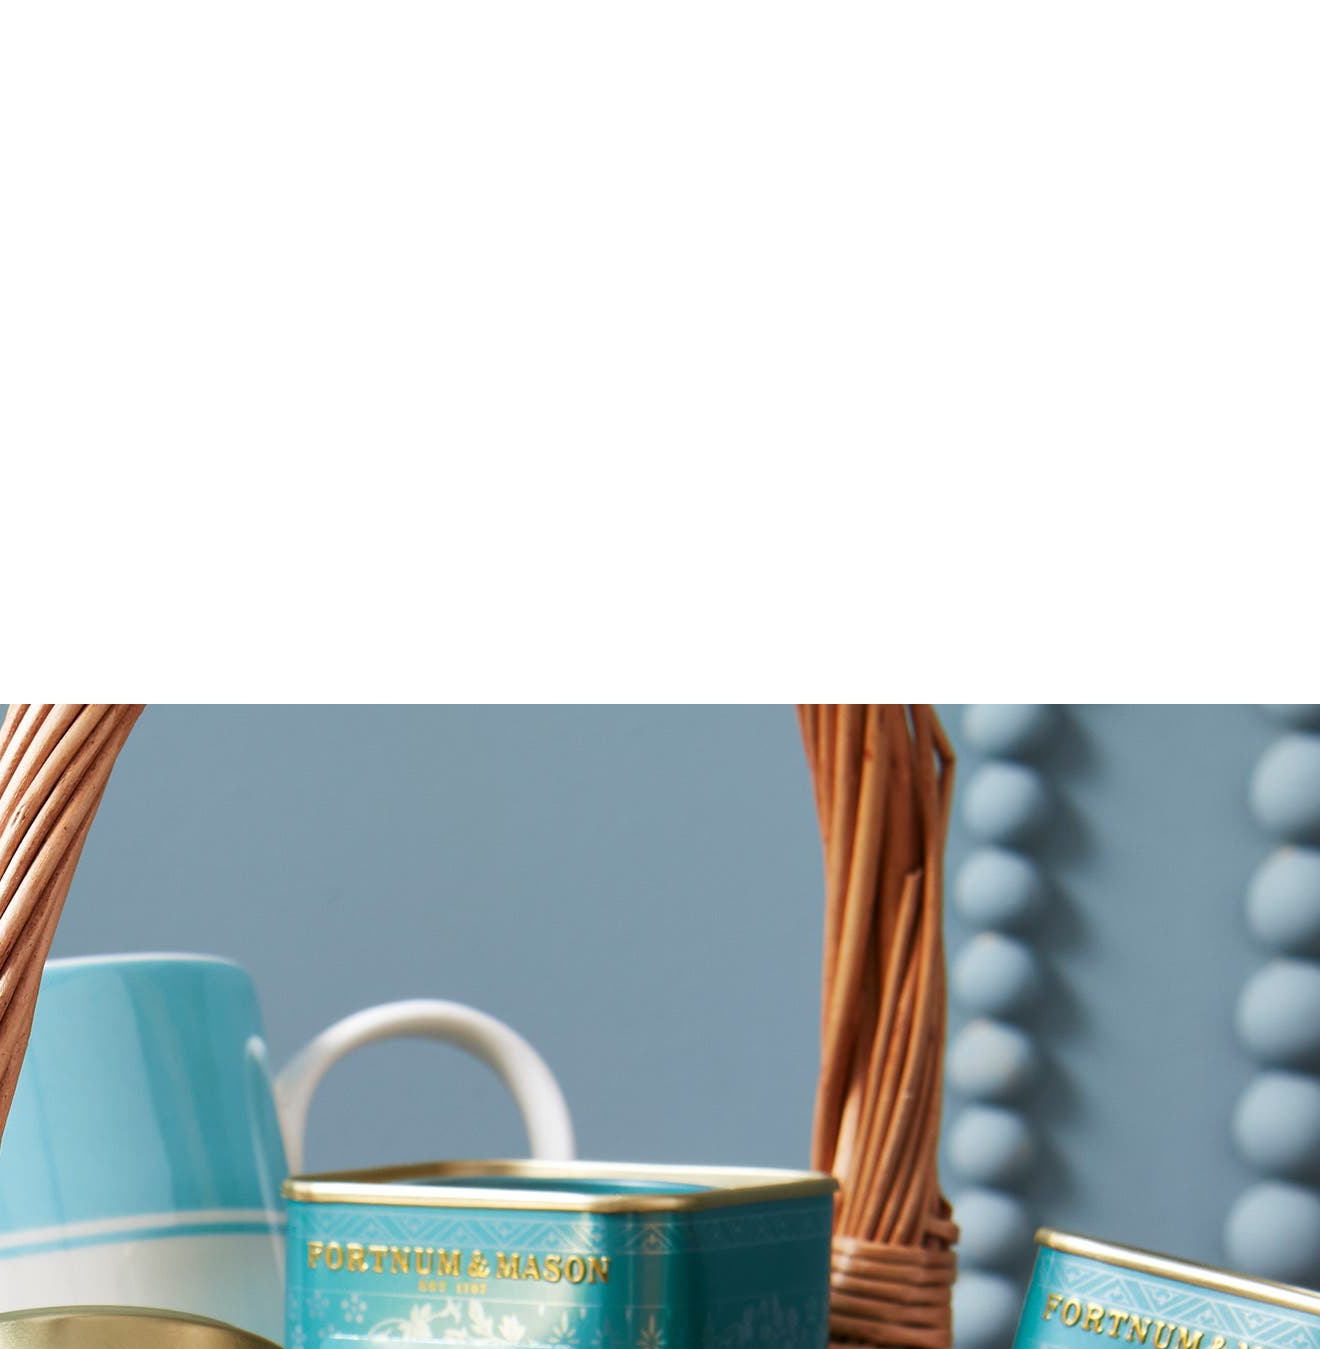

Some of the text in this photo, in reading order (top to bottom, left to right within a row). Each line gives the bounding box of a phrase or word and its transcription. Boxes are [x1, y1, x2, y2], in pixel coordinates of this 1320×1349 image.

[307, 1240, 611, 1284] FORTNUM & MASON
